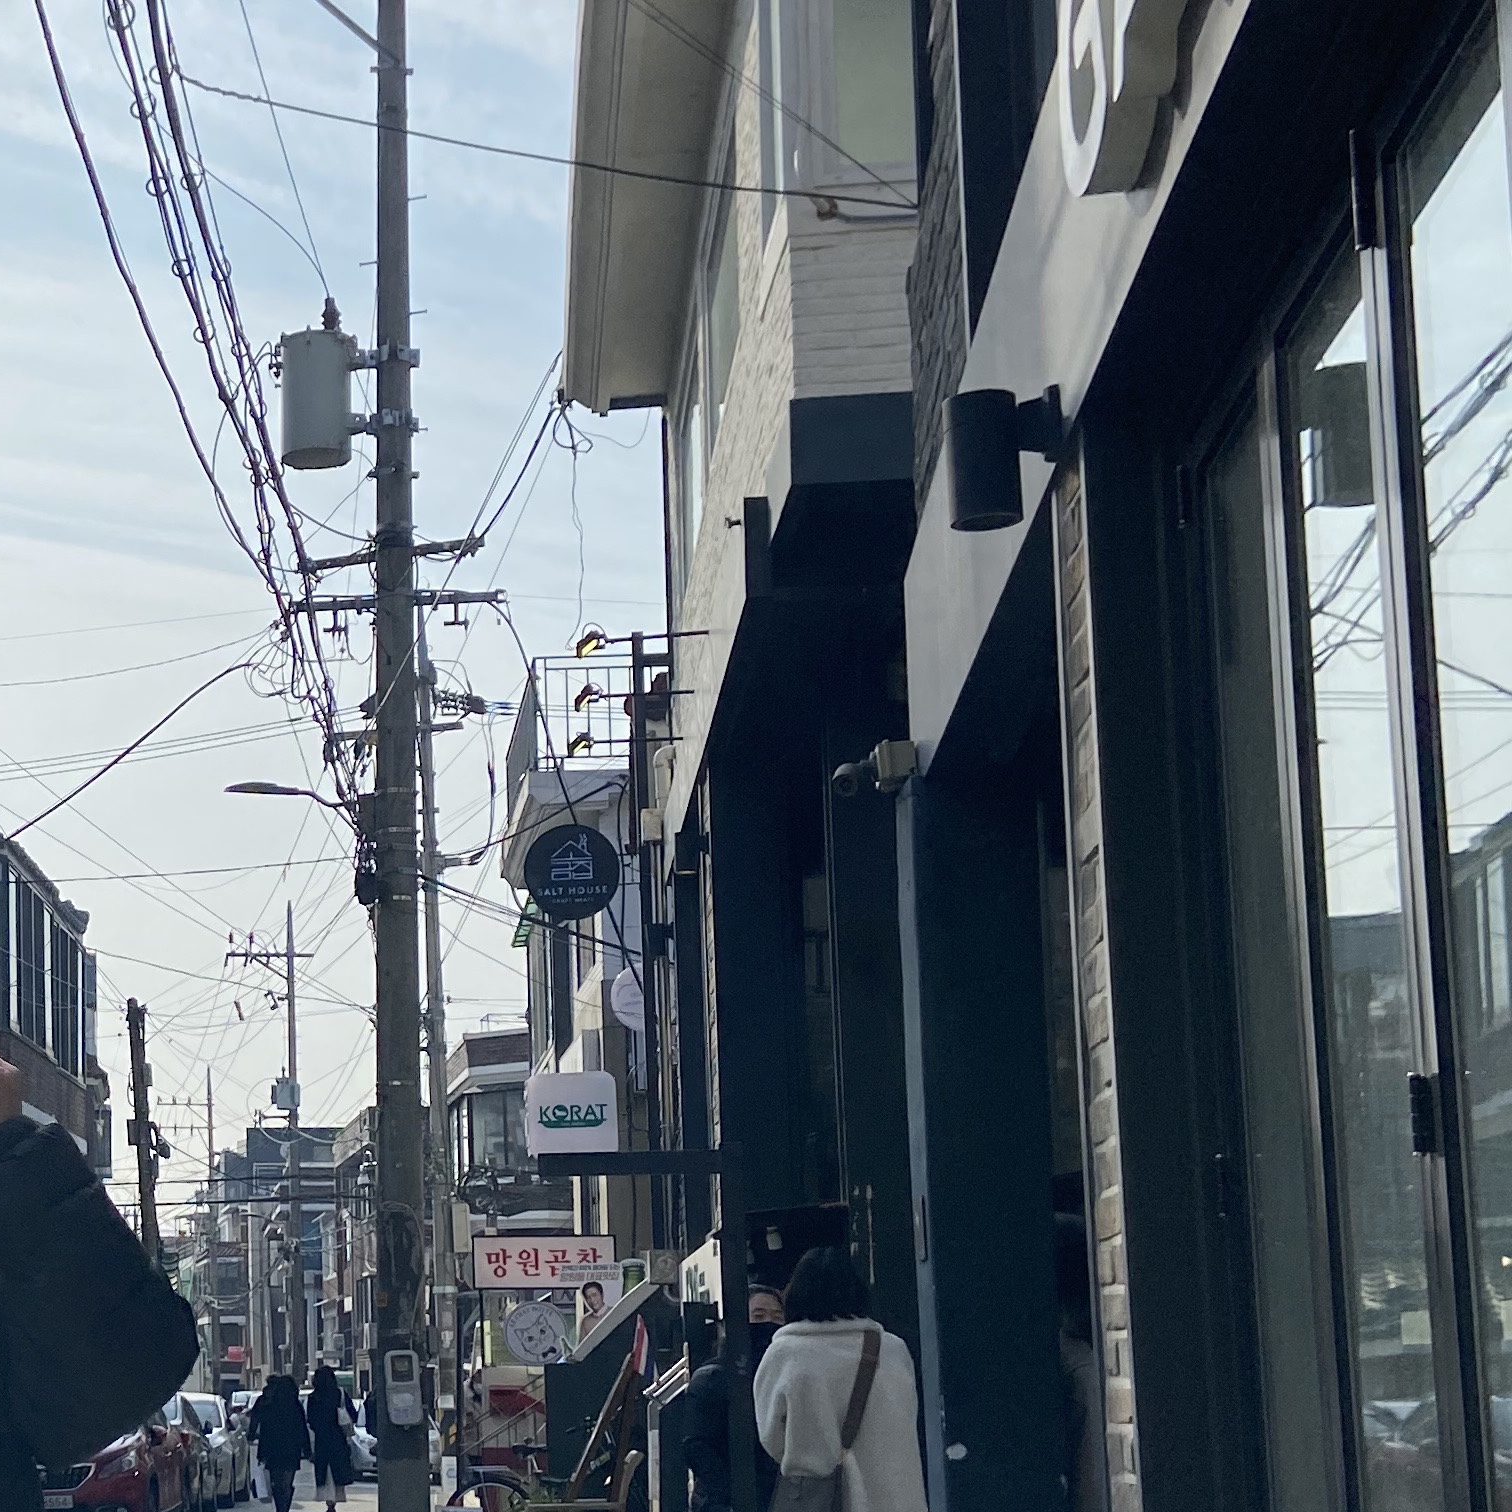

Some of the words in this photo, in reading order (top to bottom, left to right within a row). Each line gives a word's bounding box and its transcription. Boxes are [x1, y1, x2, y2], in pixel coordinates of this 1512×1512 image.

[537, 886, 564, 898] SALT
[568, 884, 608, 896] HOUSE
[538, 1103, 608, 1122] KORAT
